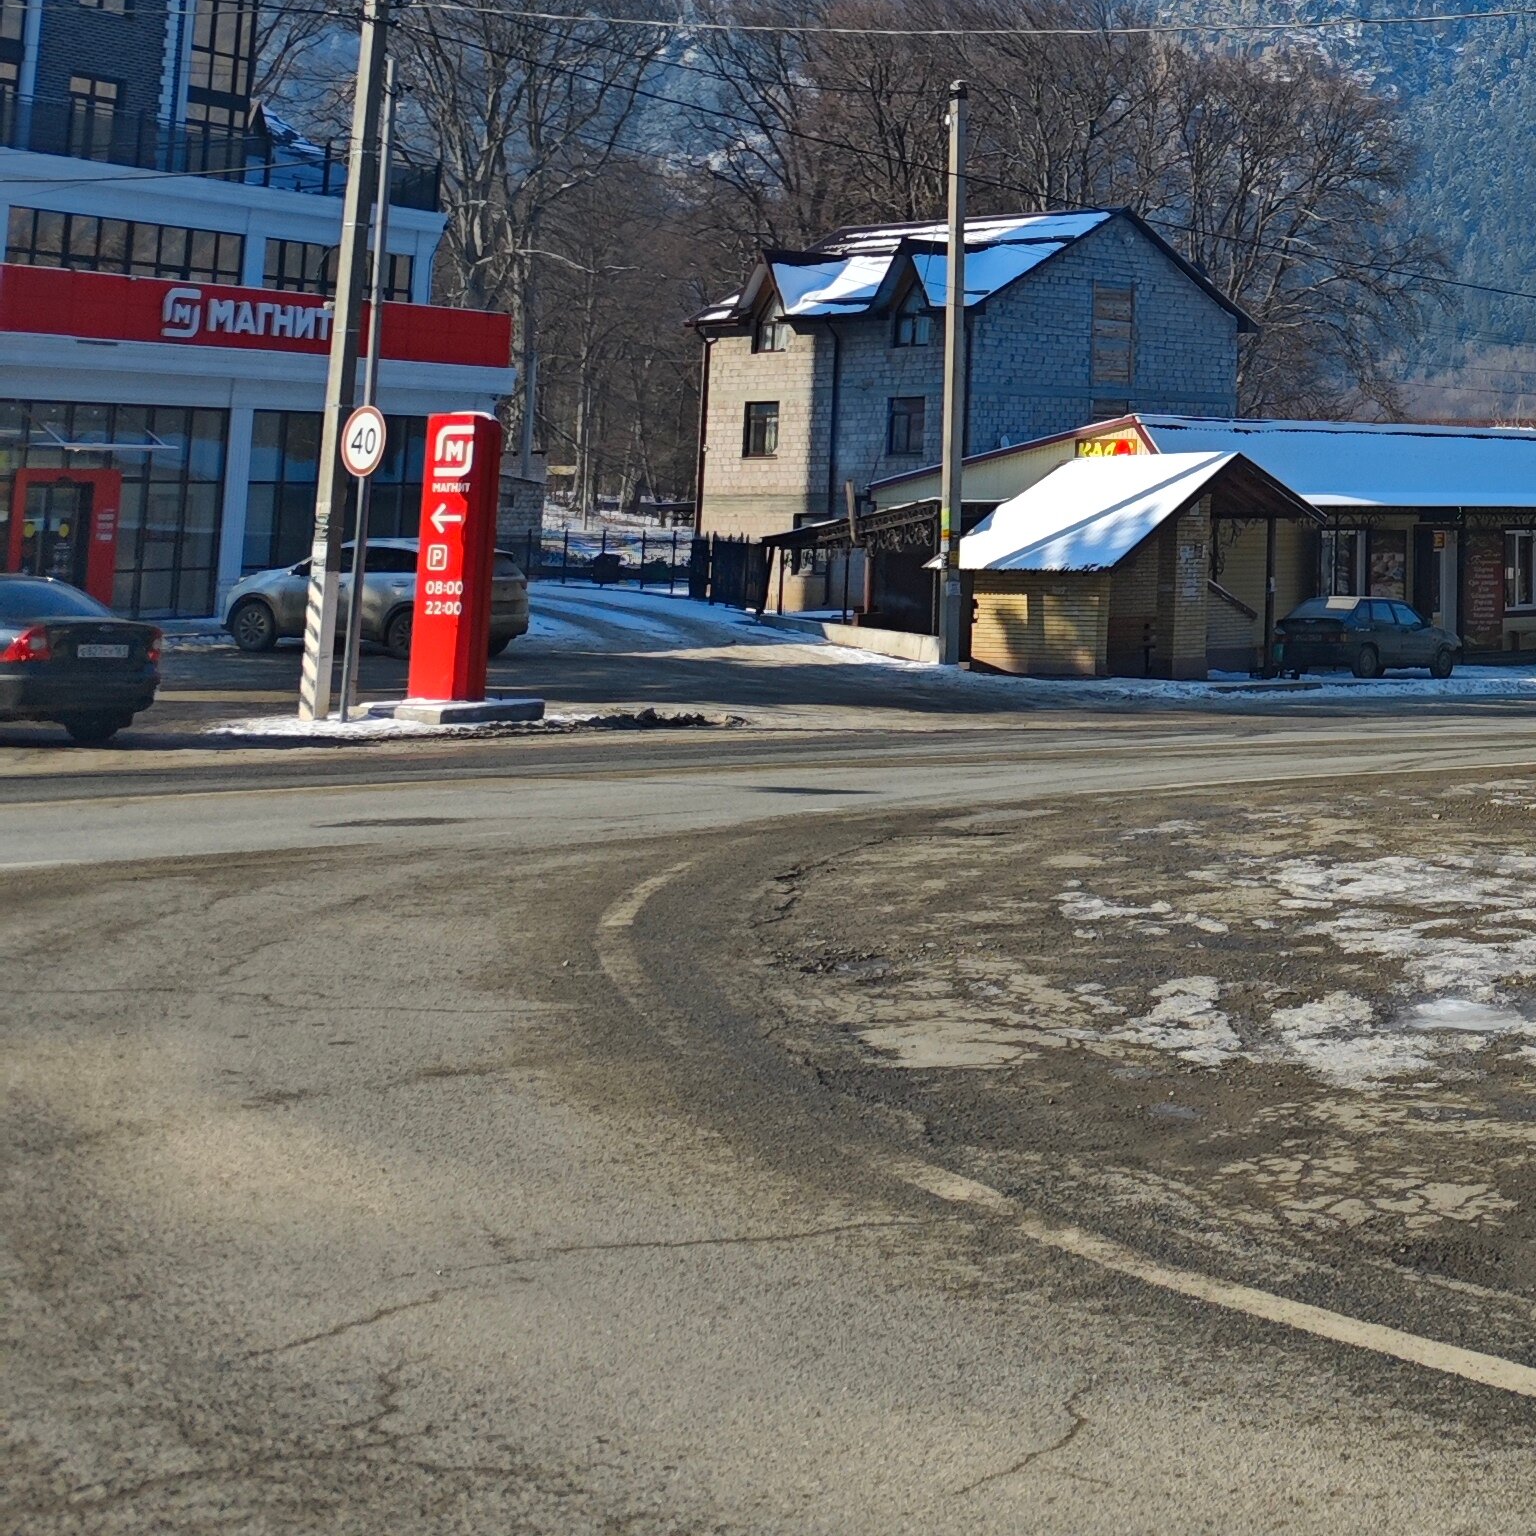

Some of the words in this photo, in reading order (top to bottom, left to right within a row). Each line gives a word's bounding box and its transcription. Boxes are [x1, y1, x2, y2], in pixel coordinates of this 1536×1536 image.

[206, 298, 334, 341] МАГНИТ
[351, 427, 376, 455] 40
[1078, 441, 1135, 457] КА
[432, 482, 471, 493] МАГНИТ
[425, 580, 463, 595] 08:00
[424, 600, 462, 615] 22:00
